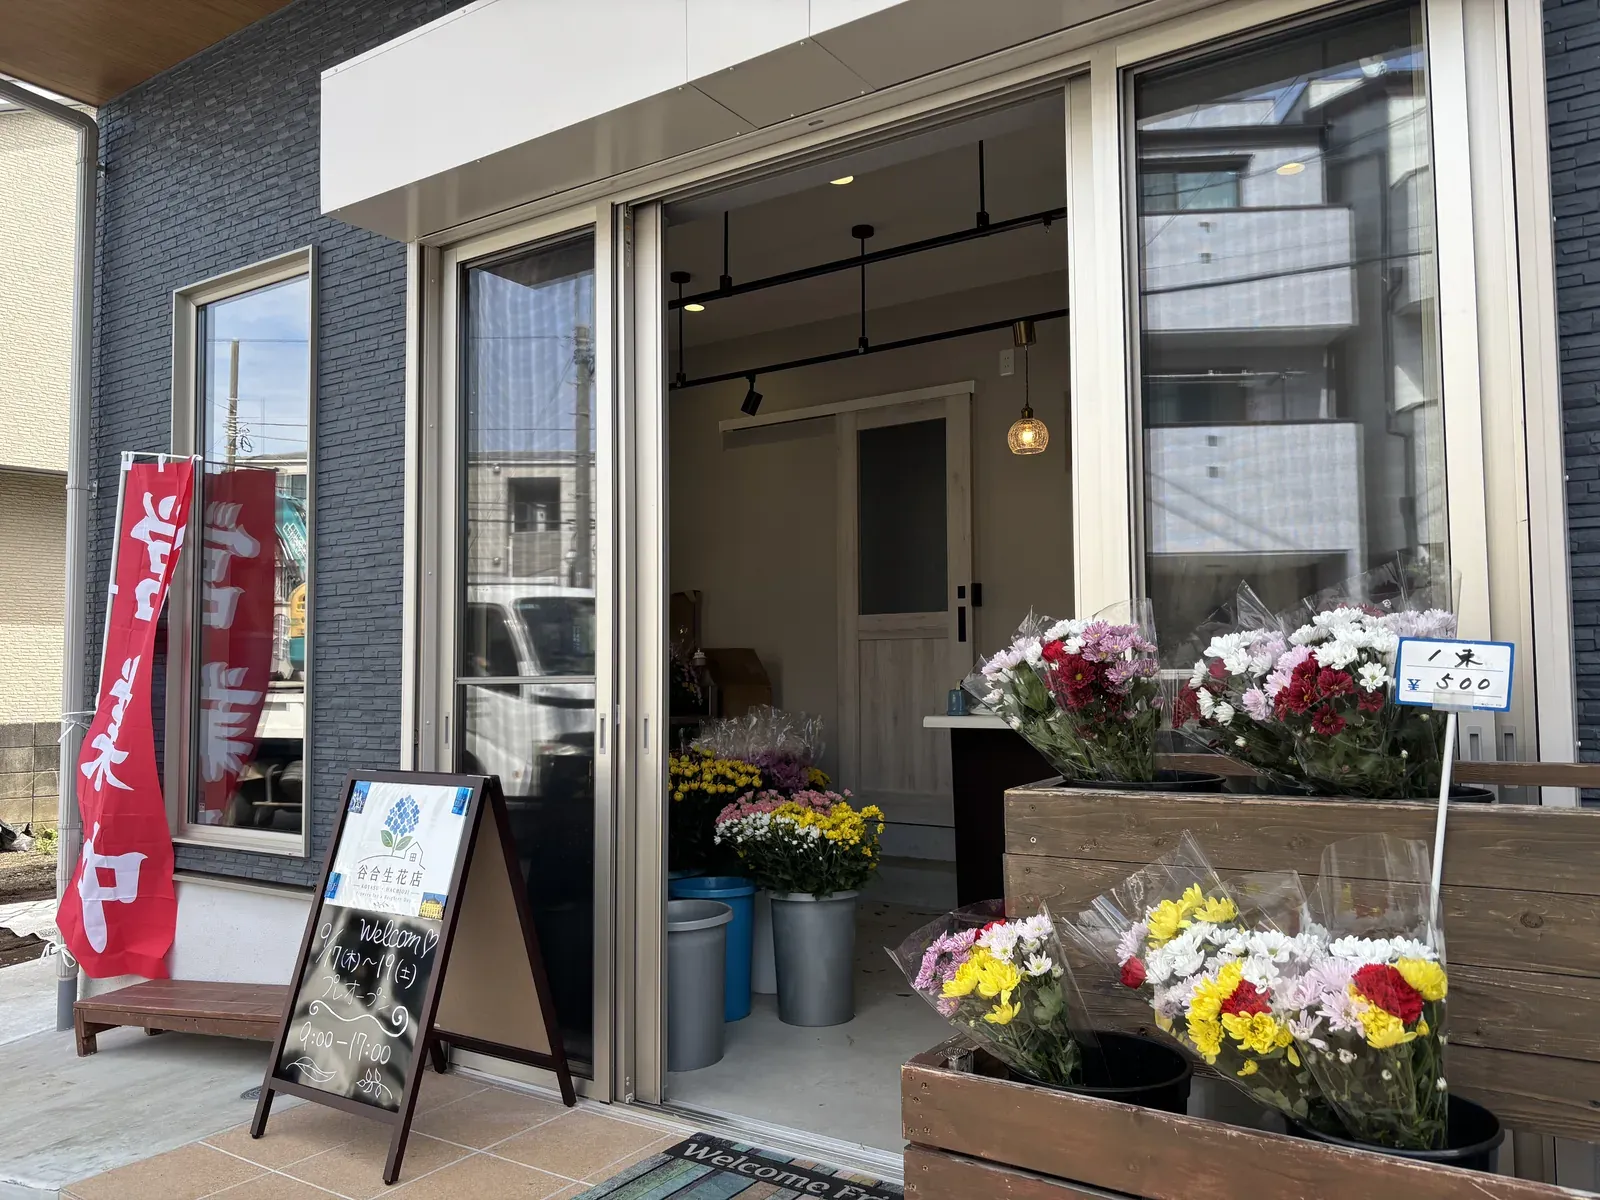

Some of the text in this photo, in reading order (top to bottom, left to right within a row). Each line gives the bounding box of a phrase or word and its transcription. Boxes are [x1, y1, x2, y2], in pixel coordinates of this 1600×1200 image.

[357, 864, 424, 888] 谷合生花店
[322, 973, 390, 1011] プレオープン
[684, 1142, 831, 1193] Welcome
